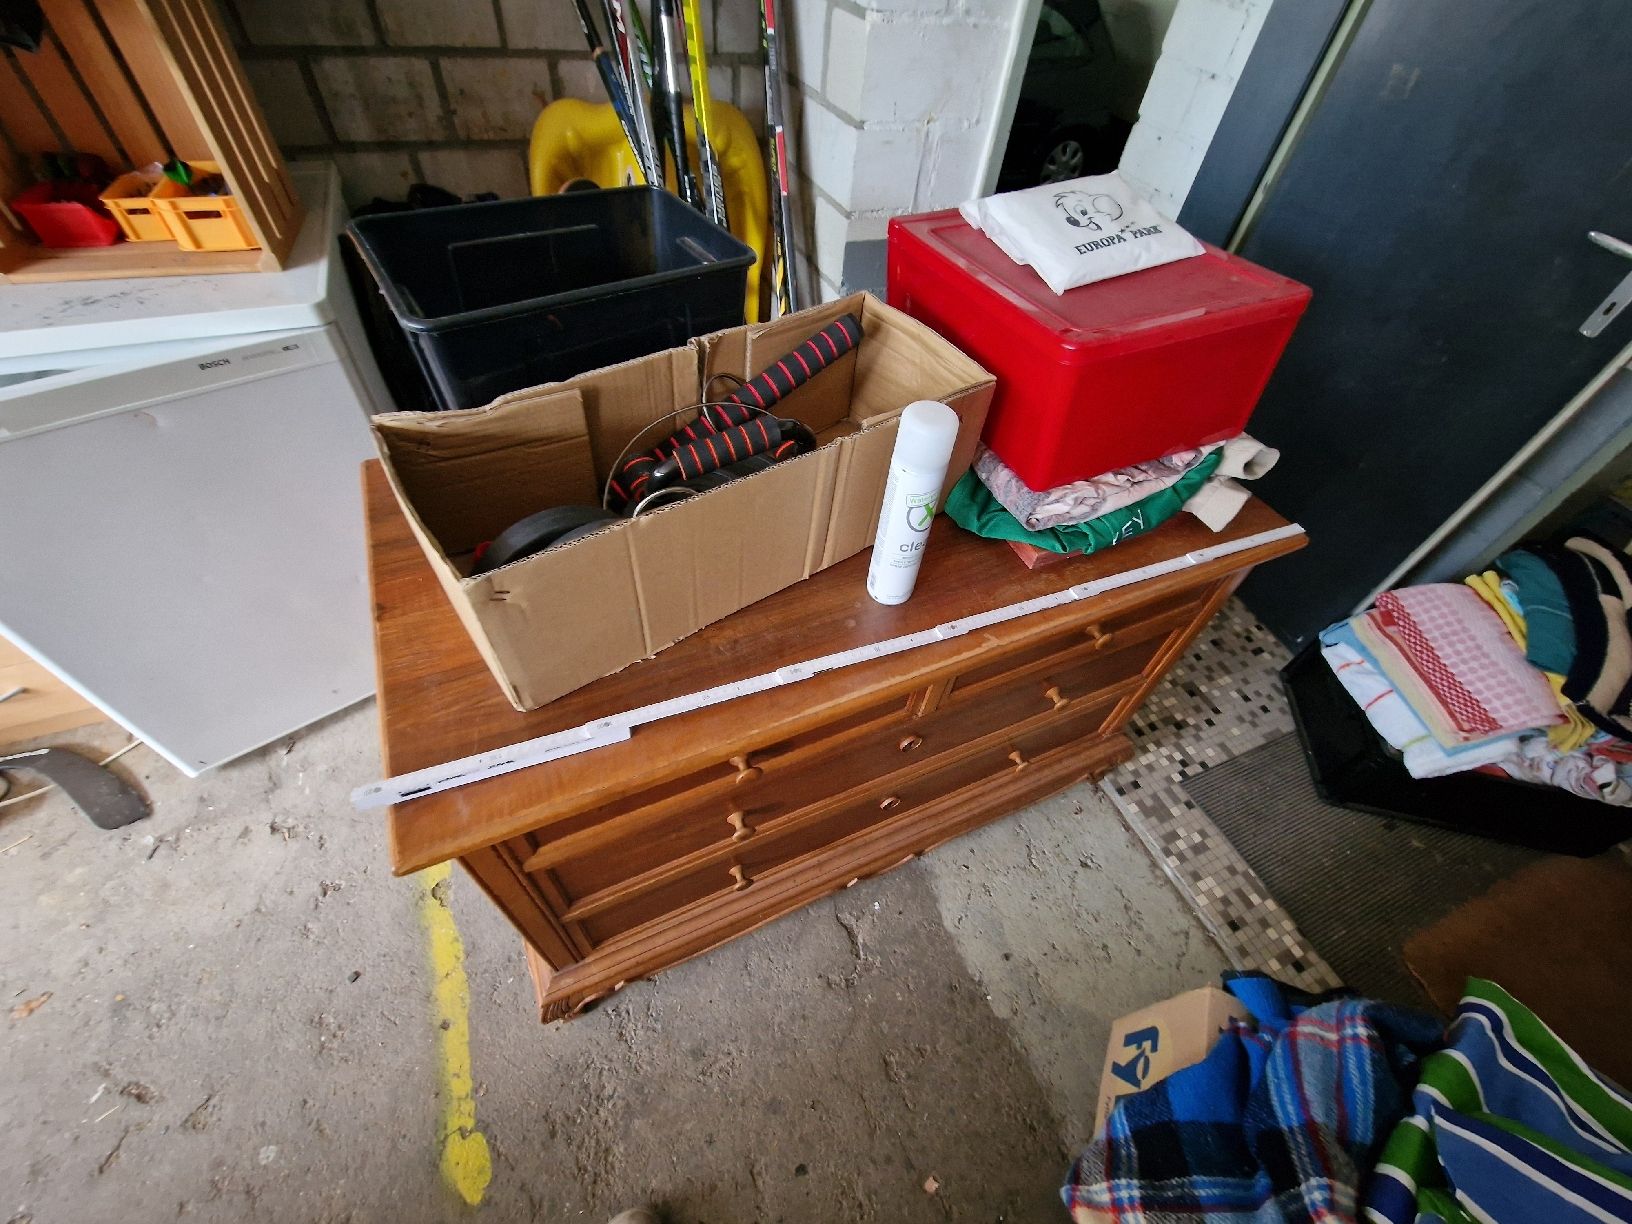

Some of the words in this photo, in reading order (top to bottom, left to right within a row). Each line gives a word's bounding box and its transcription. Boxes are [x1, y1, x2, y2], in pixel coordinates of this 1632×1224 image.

[1074, 233, 1127, 255] EUROPA
[1129, 225, 1162, 239] PARK
[198, 358, 231, 371] BOSCH
